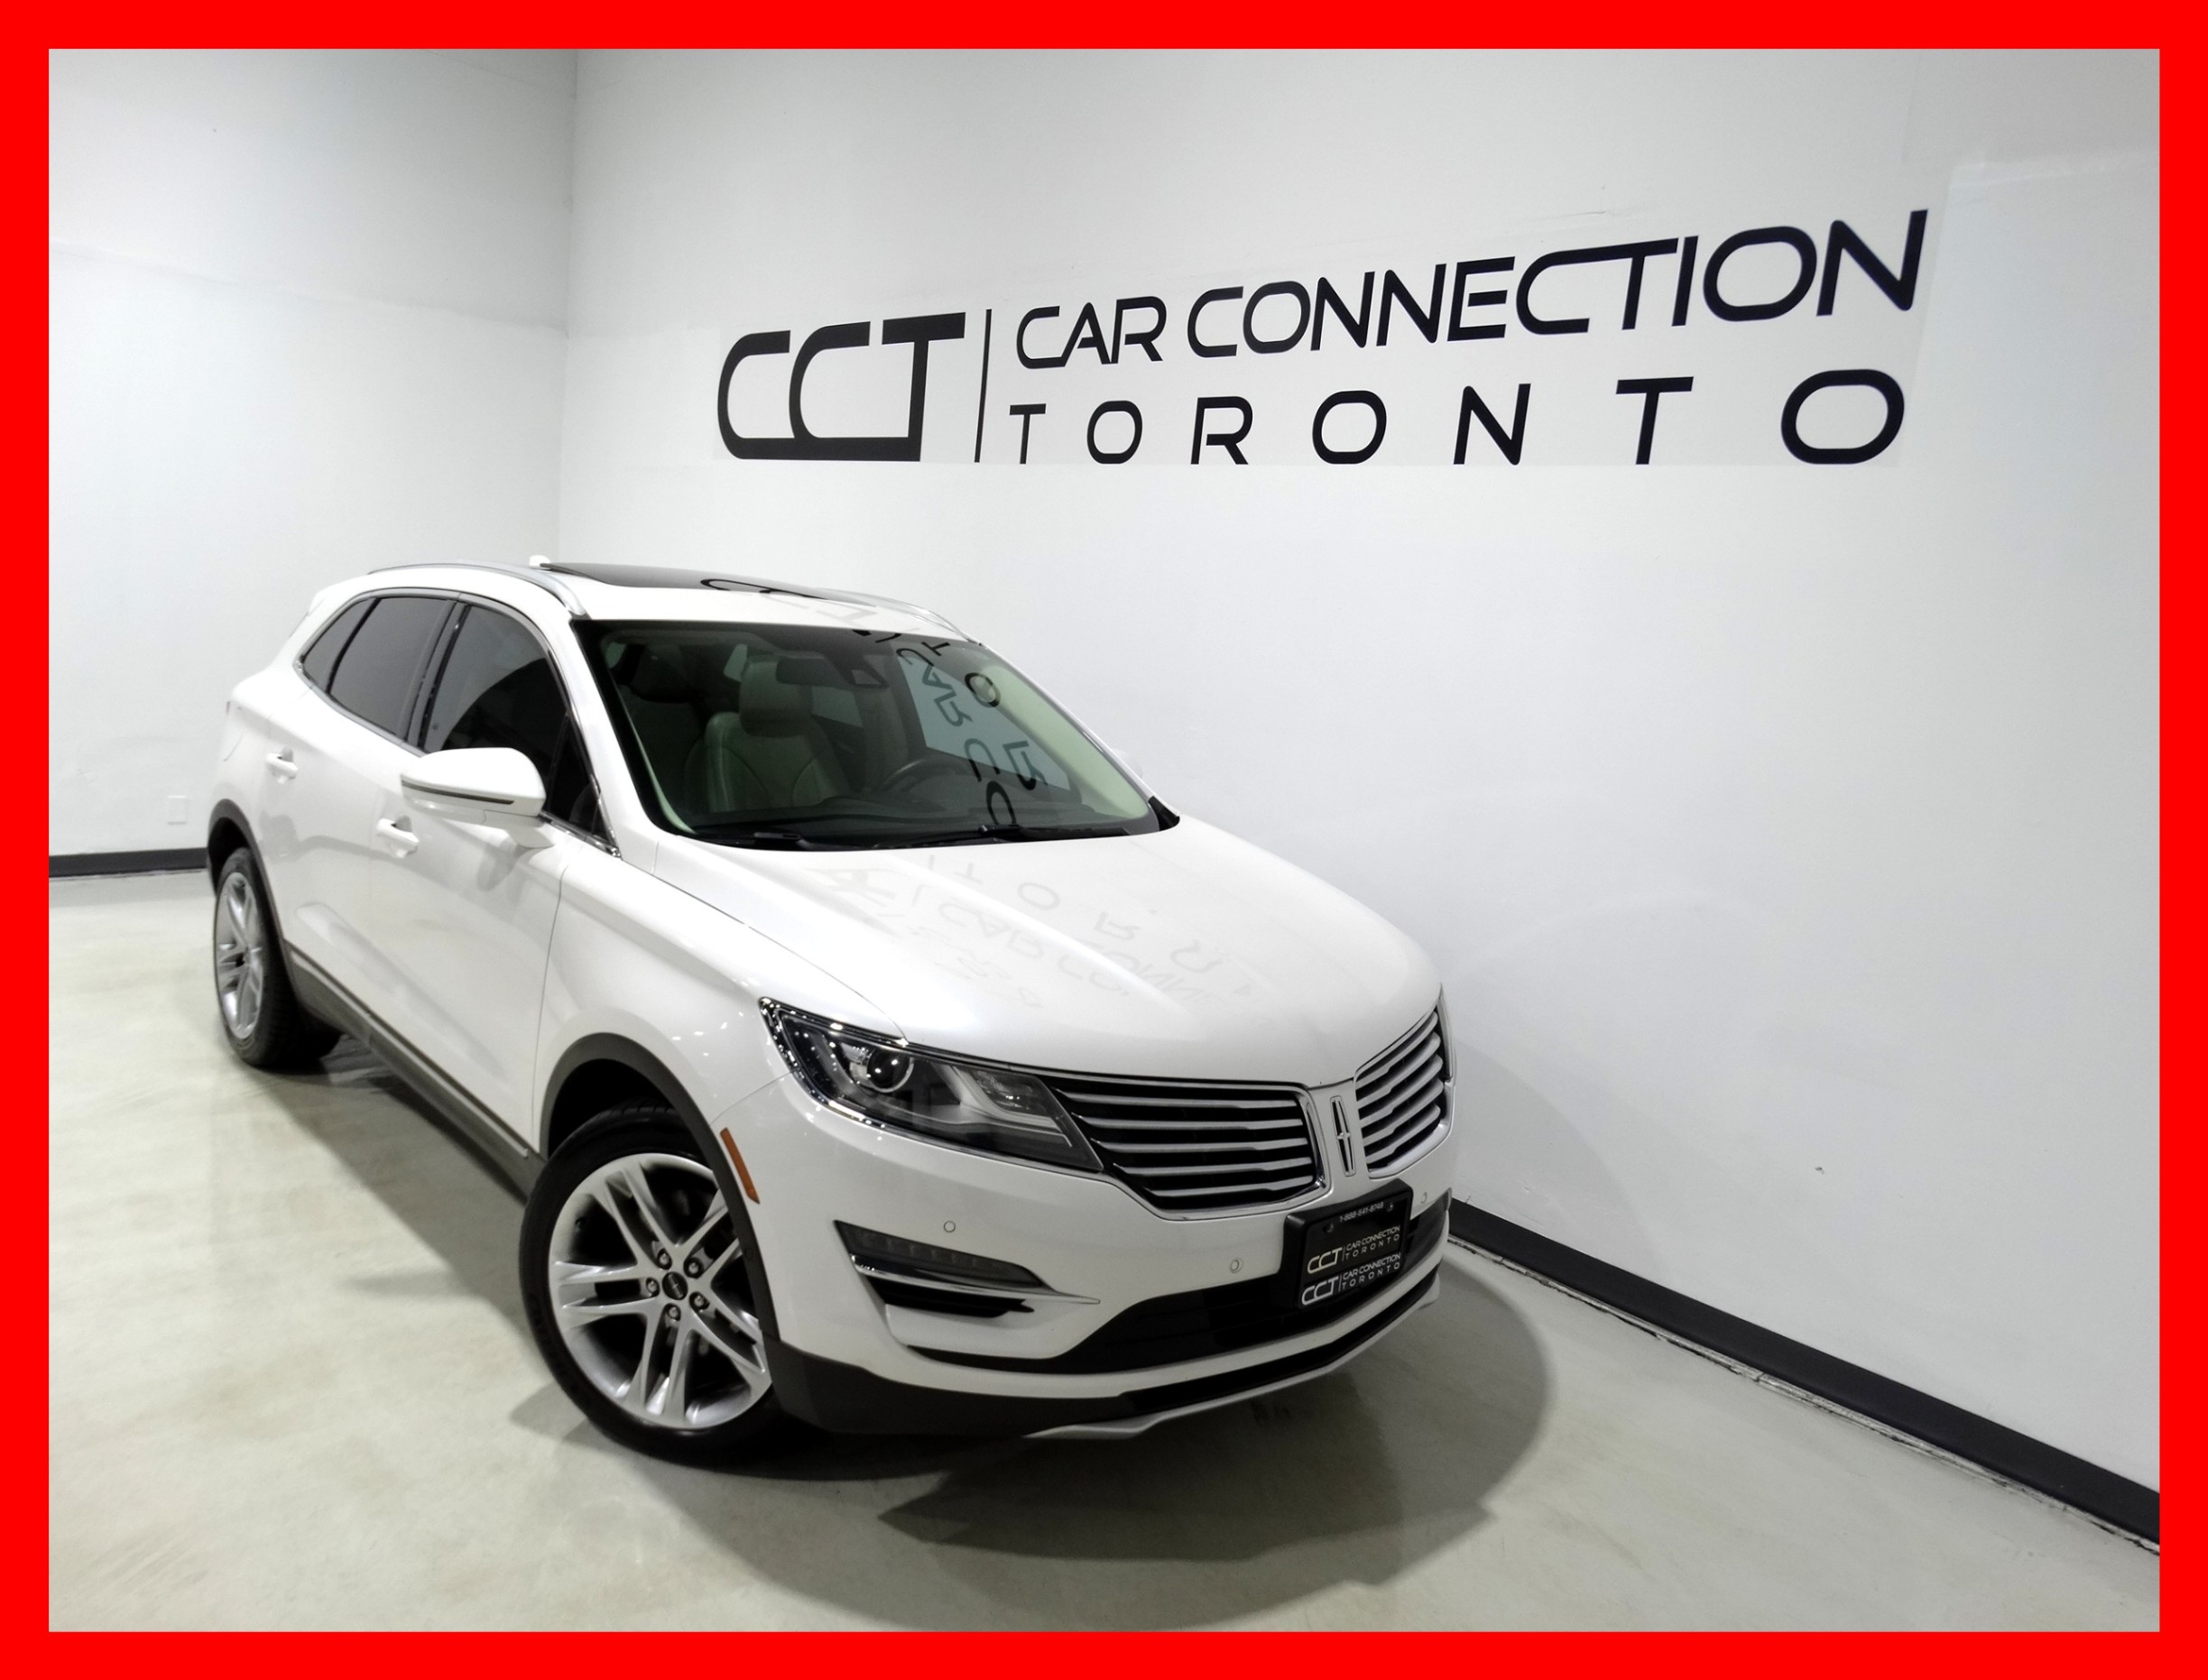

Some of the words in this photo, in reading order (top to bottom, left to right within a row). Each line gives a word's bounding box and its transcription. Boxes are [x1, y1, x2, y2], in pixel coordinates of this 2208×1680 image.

[1017, 296, 1167, 369] CAR
[1187, 209, 1927, 357] CONNECTION
[717, 312, 965, 461] CCT
[1010, 369, 1905, 465] TORONTO
[1345, 1233, 1400, 1260] TORONTO
[1346, 1240, 1362, 1251] CAR
[1362, 1225, 1401, 1245] CONNECTION
[1307, 1247, 1343, 1274] CCT
[1343, 1269, 1359, 1280] CAR
[1359, 1252, 1401, 1274] CONNECTION
[1342, 1262, 1400, 1290] TORONTO
[1301, 1276, 1339, 1306] CCT
